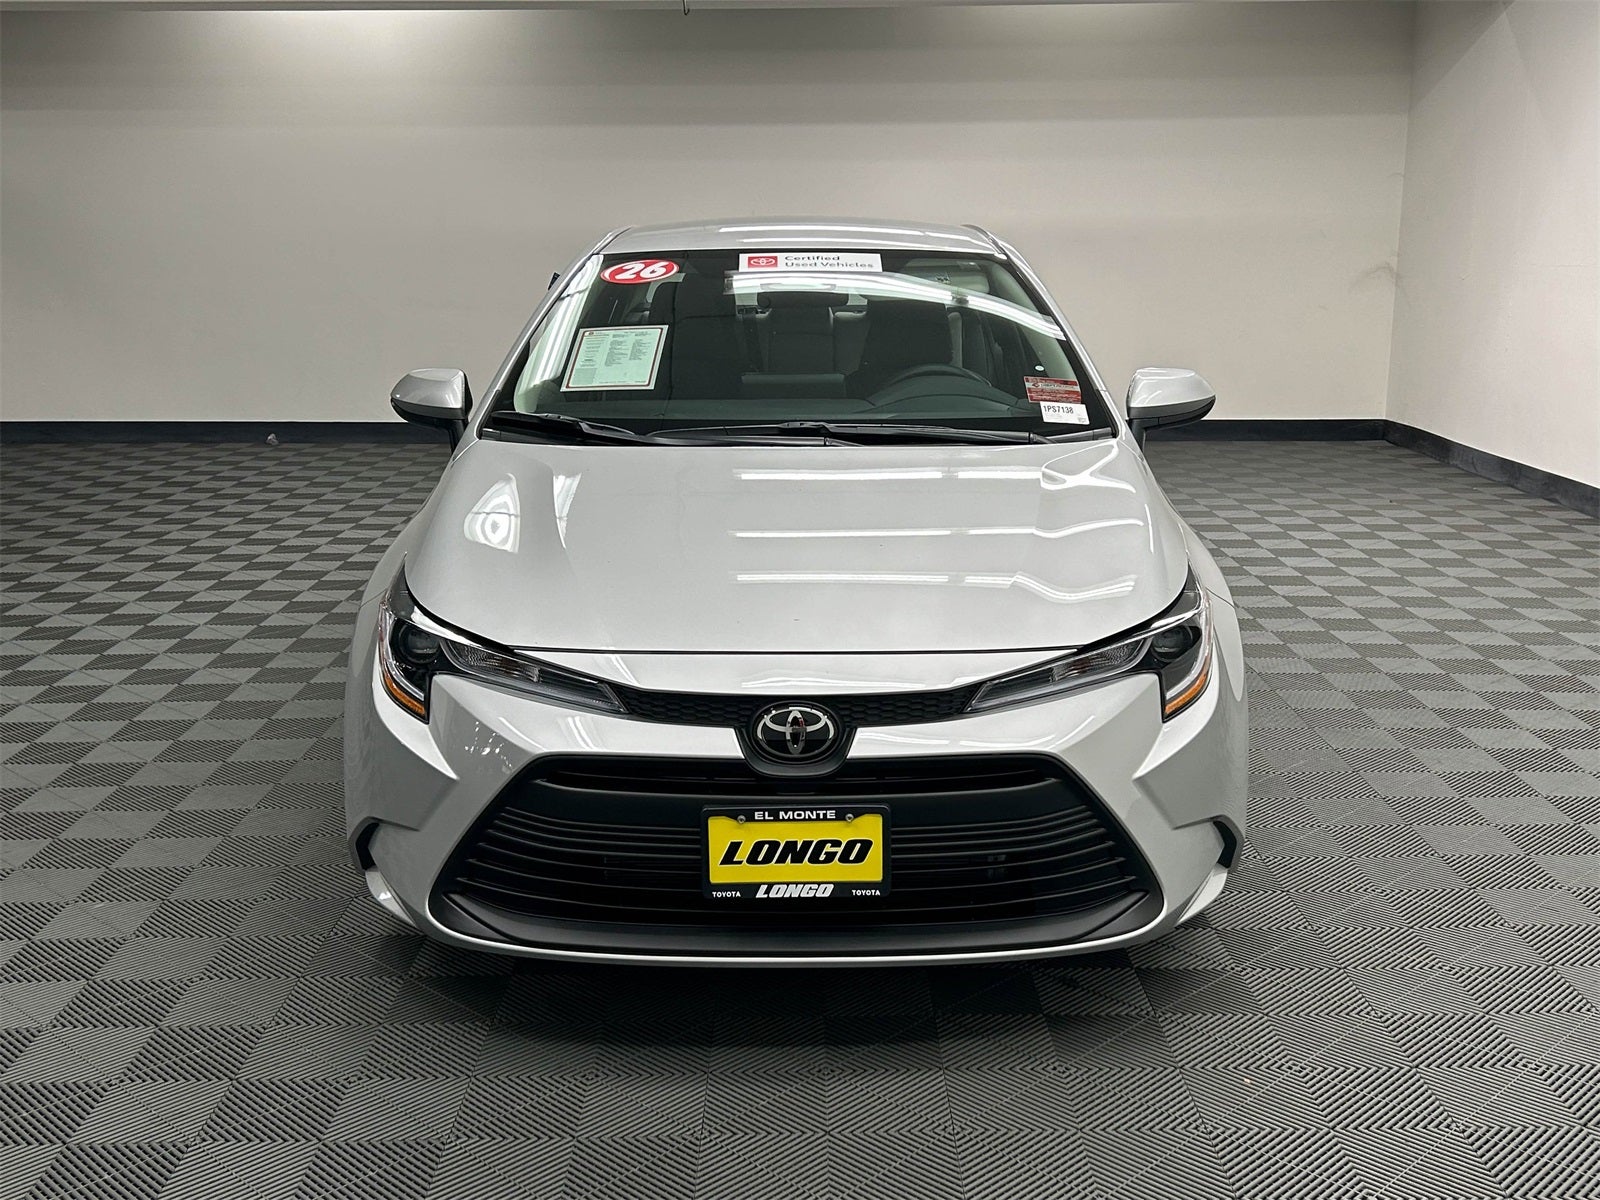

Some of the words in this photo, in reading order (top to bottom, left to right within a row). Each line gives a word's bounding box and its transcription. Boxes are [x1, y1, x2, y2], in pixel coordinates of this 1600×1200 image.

[614, 261, 669, 280] 26
[1043, 405, 1074, 414] 1PS7138
[755, 811, 774, 820] EL
[779, 810, 836, 820] MONTE
[719, 838, 874, 867] LONGO
[755, 884, 835, 899] LONGO
